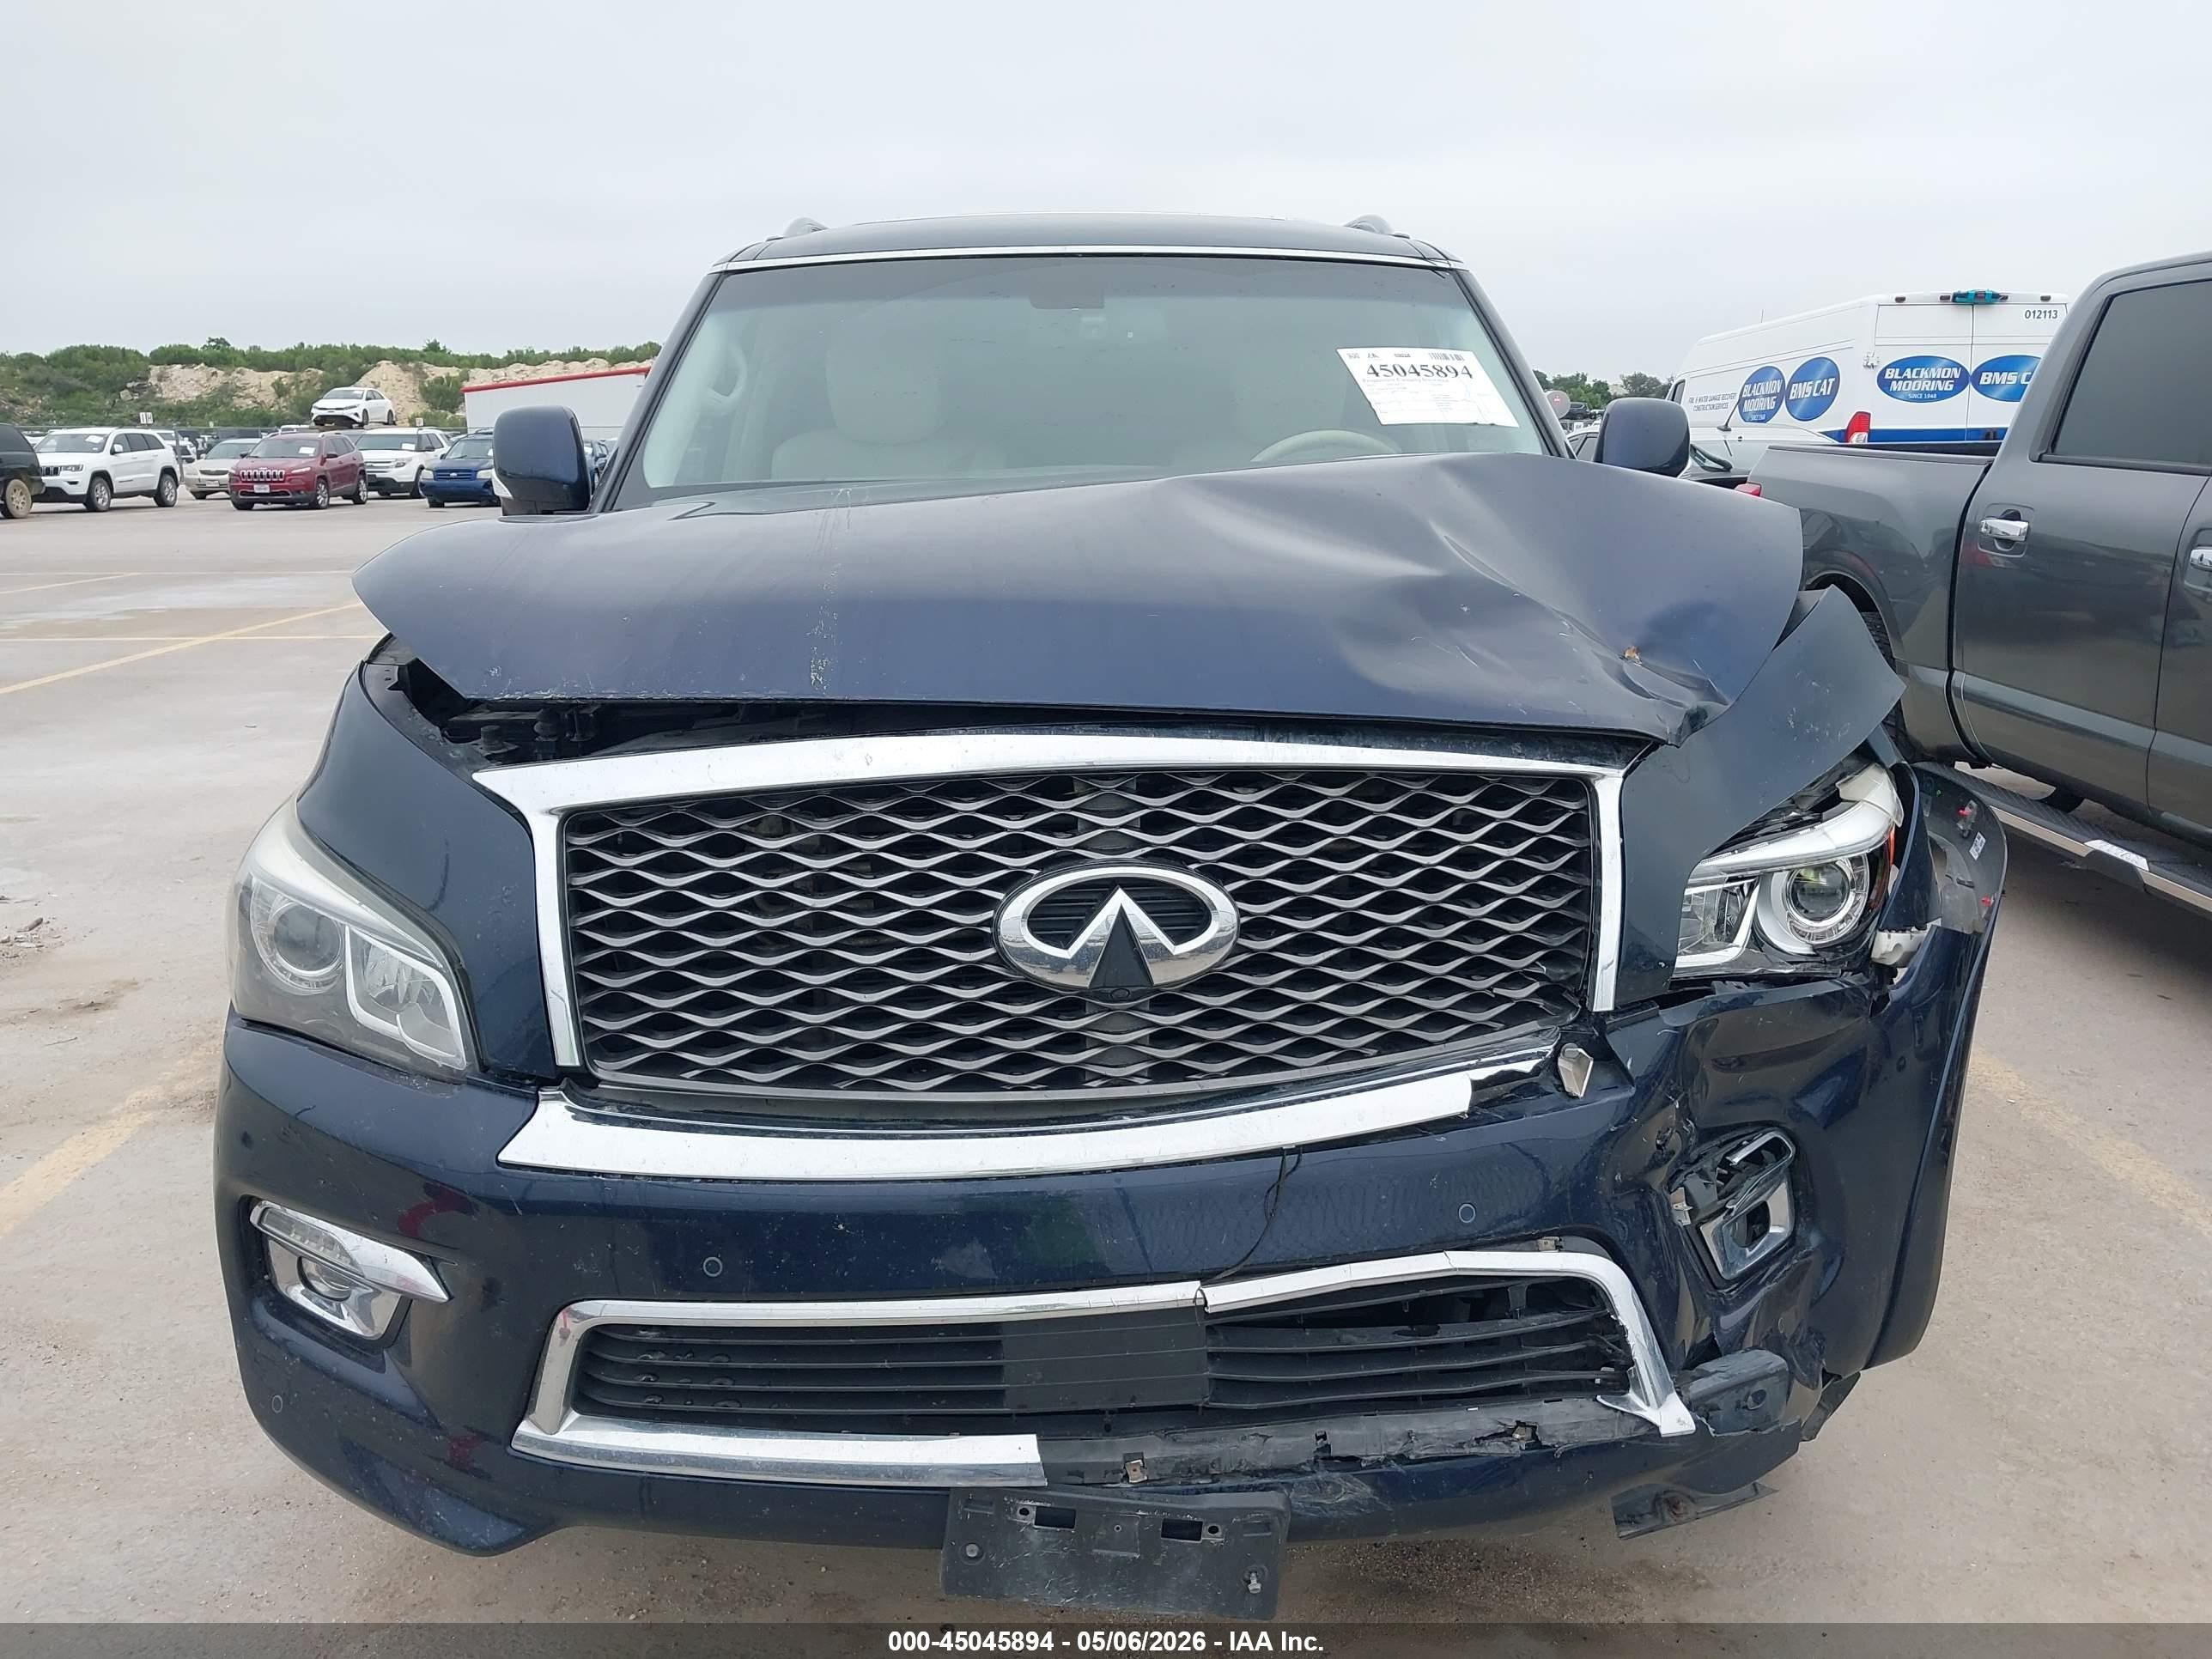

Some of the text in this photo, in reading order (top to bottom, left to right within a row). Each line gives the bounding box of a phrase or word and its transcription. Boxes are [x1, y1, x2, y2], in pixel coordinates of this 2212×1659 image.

[2024, 309, 2058, 319] 012113
[1366, 363, 1474, 380] 45045894
[1884, 367, 1962, 380] BLACKMON
[1979, 371, 2034, 385] BMS C
[1742, 380, 1783, 398] BLACKMON
[1789, 377, 1836, 400] BMS CAT
[1889, 380, 1954, 392] MOORING
[1742, 396, 1778, 413] MOORING
